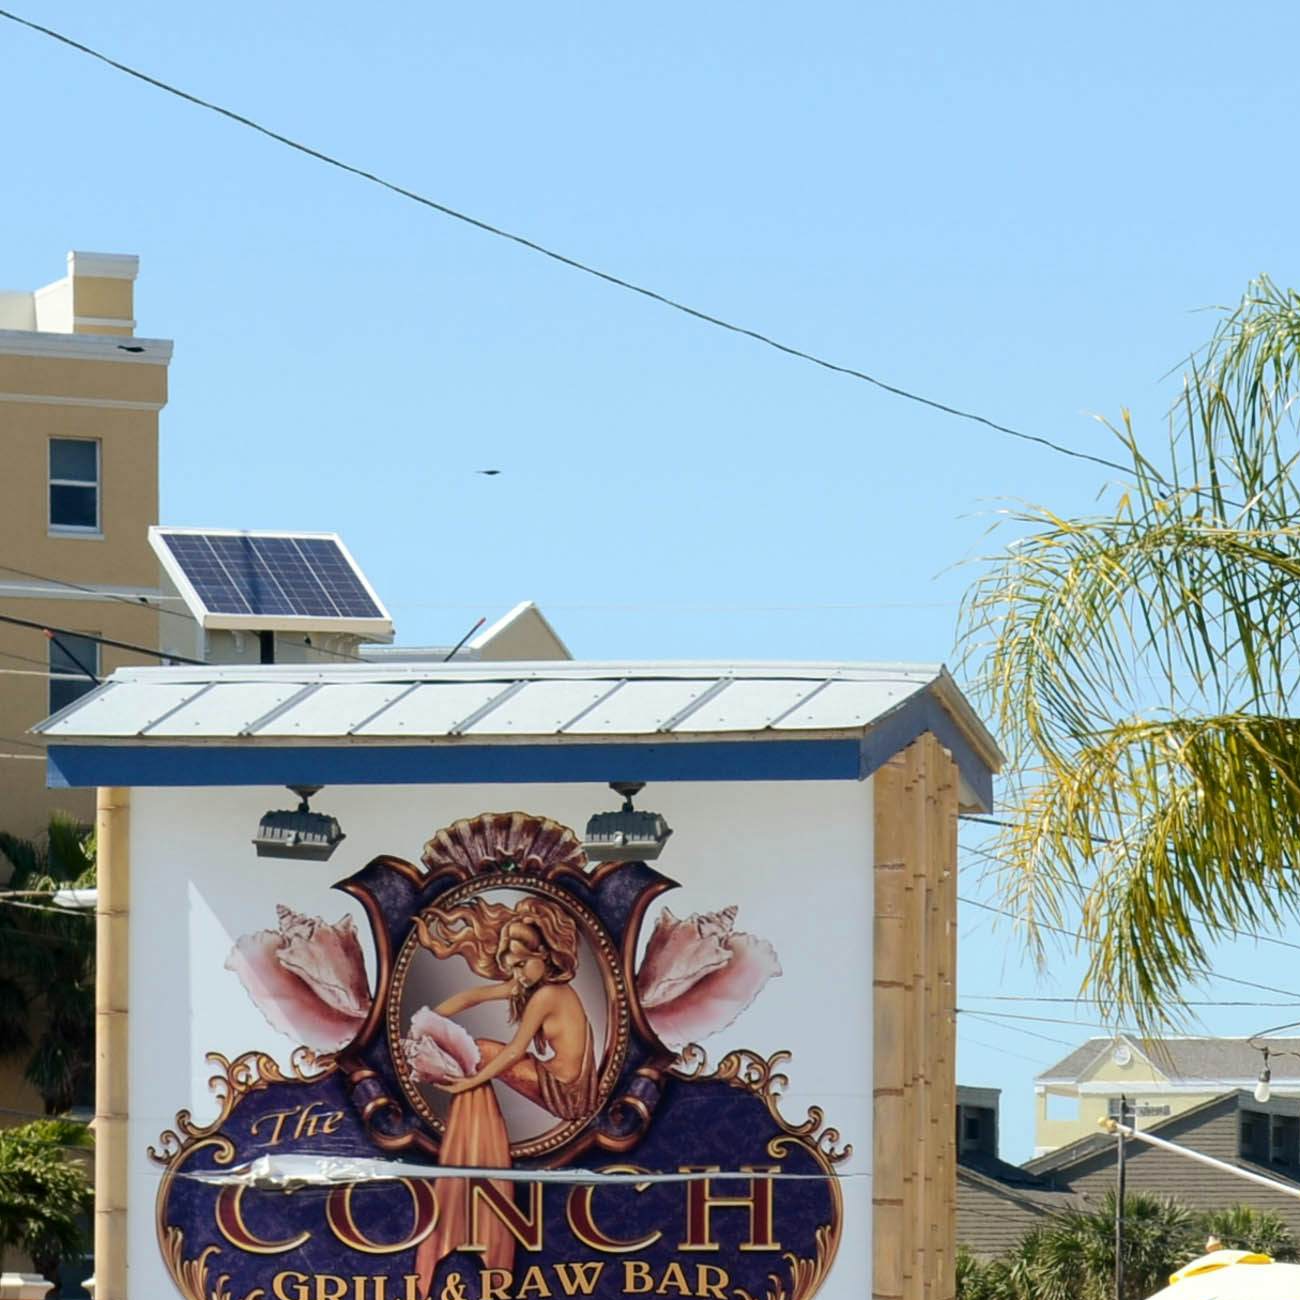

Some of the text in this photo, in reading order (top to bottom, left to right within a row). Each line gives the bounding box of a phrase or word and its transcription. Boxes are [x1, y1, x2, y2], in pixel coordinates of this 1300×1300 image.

[251, 1101, 344, 1147] The
[215, 1164, 781, 1254] CONCH
[622, 1260, 730, 1300] BAR
